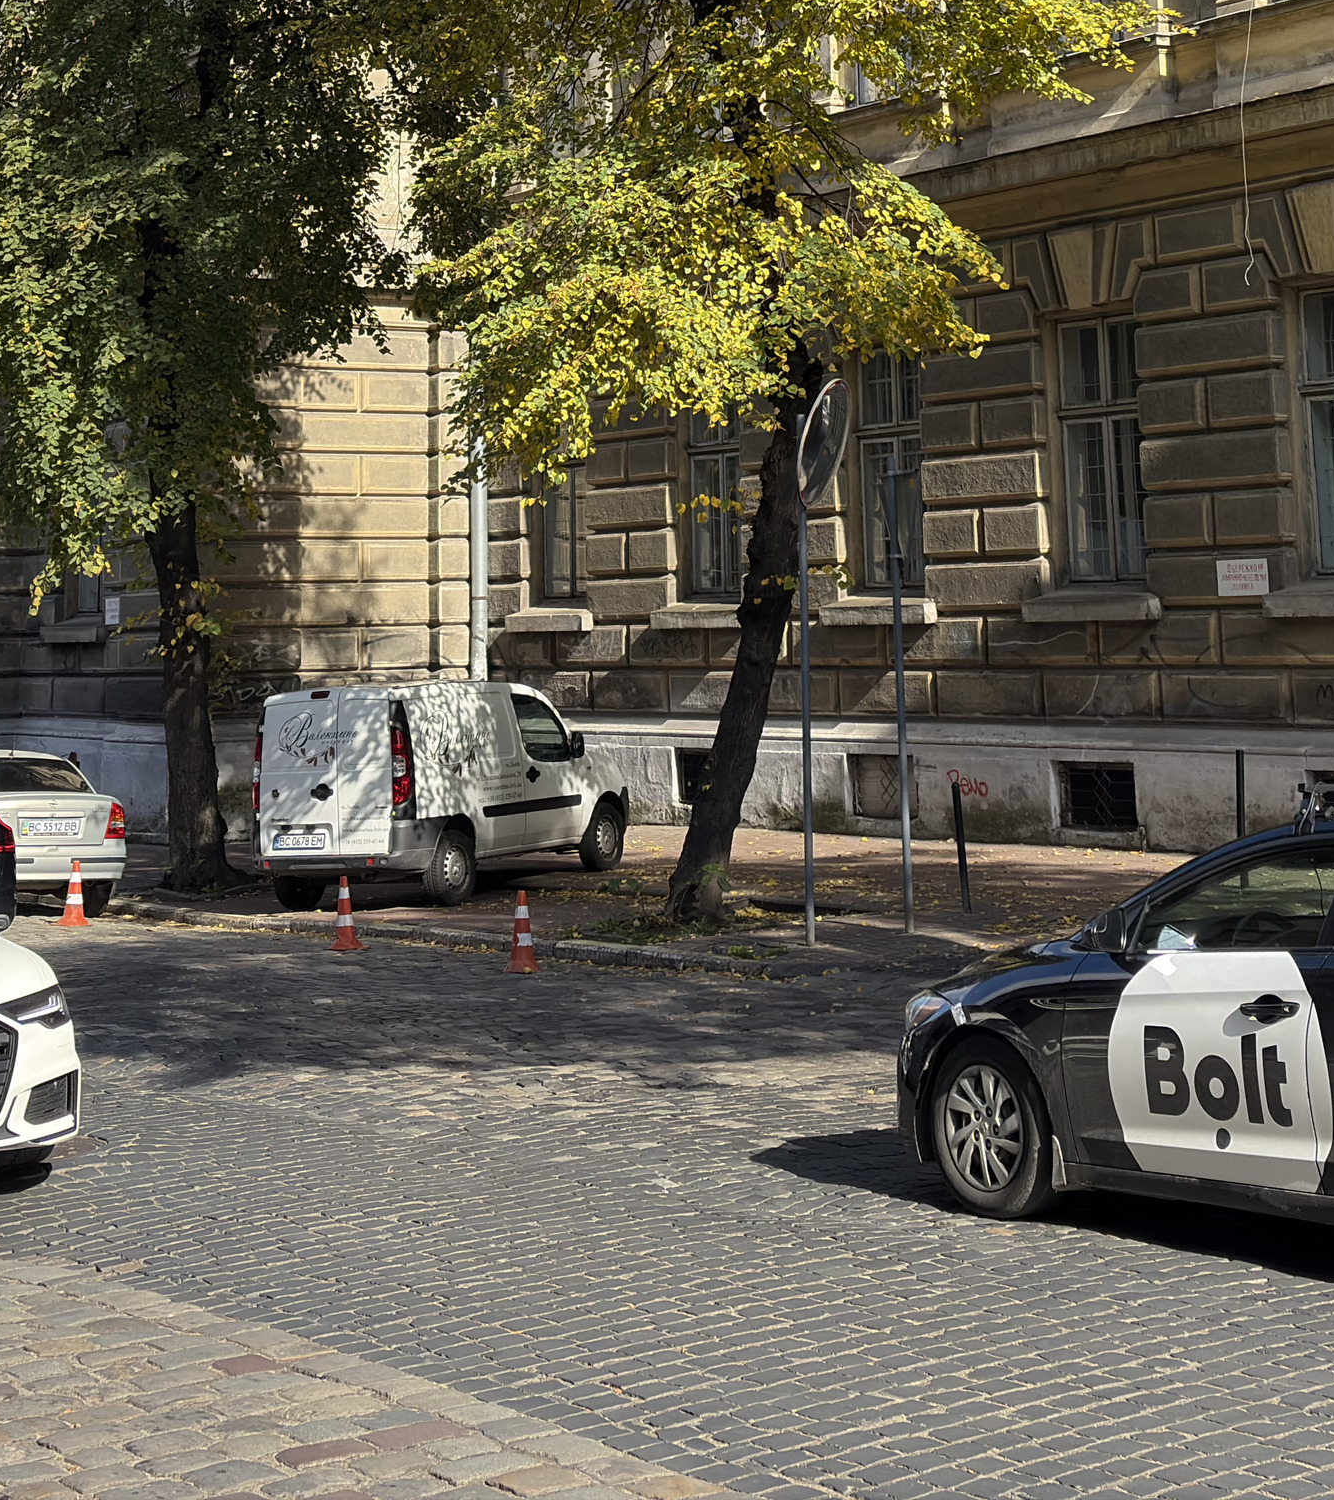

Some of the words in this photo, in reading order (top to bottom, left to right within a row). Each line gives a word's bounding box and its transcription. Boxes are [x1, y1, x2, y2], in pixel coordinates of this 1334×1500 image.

[28, 822, 41, 832] BC
[43, 822, 62, 832] 5512
[64, 821, 77, 831] BB
[279, 836, 291, 847] BC
[291, 836, 310, 846] 0678
[310, 836, 323, 846] EM
[1144, 1025, 1293, 1150] Bolt
